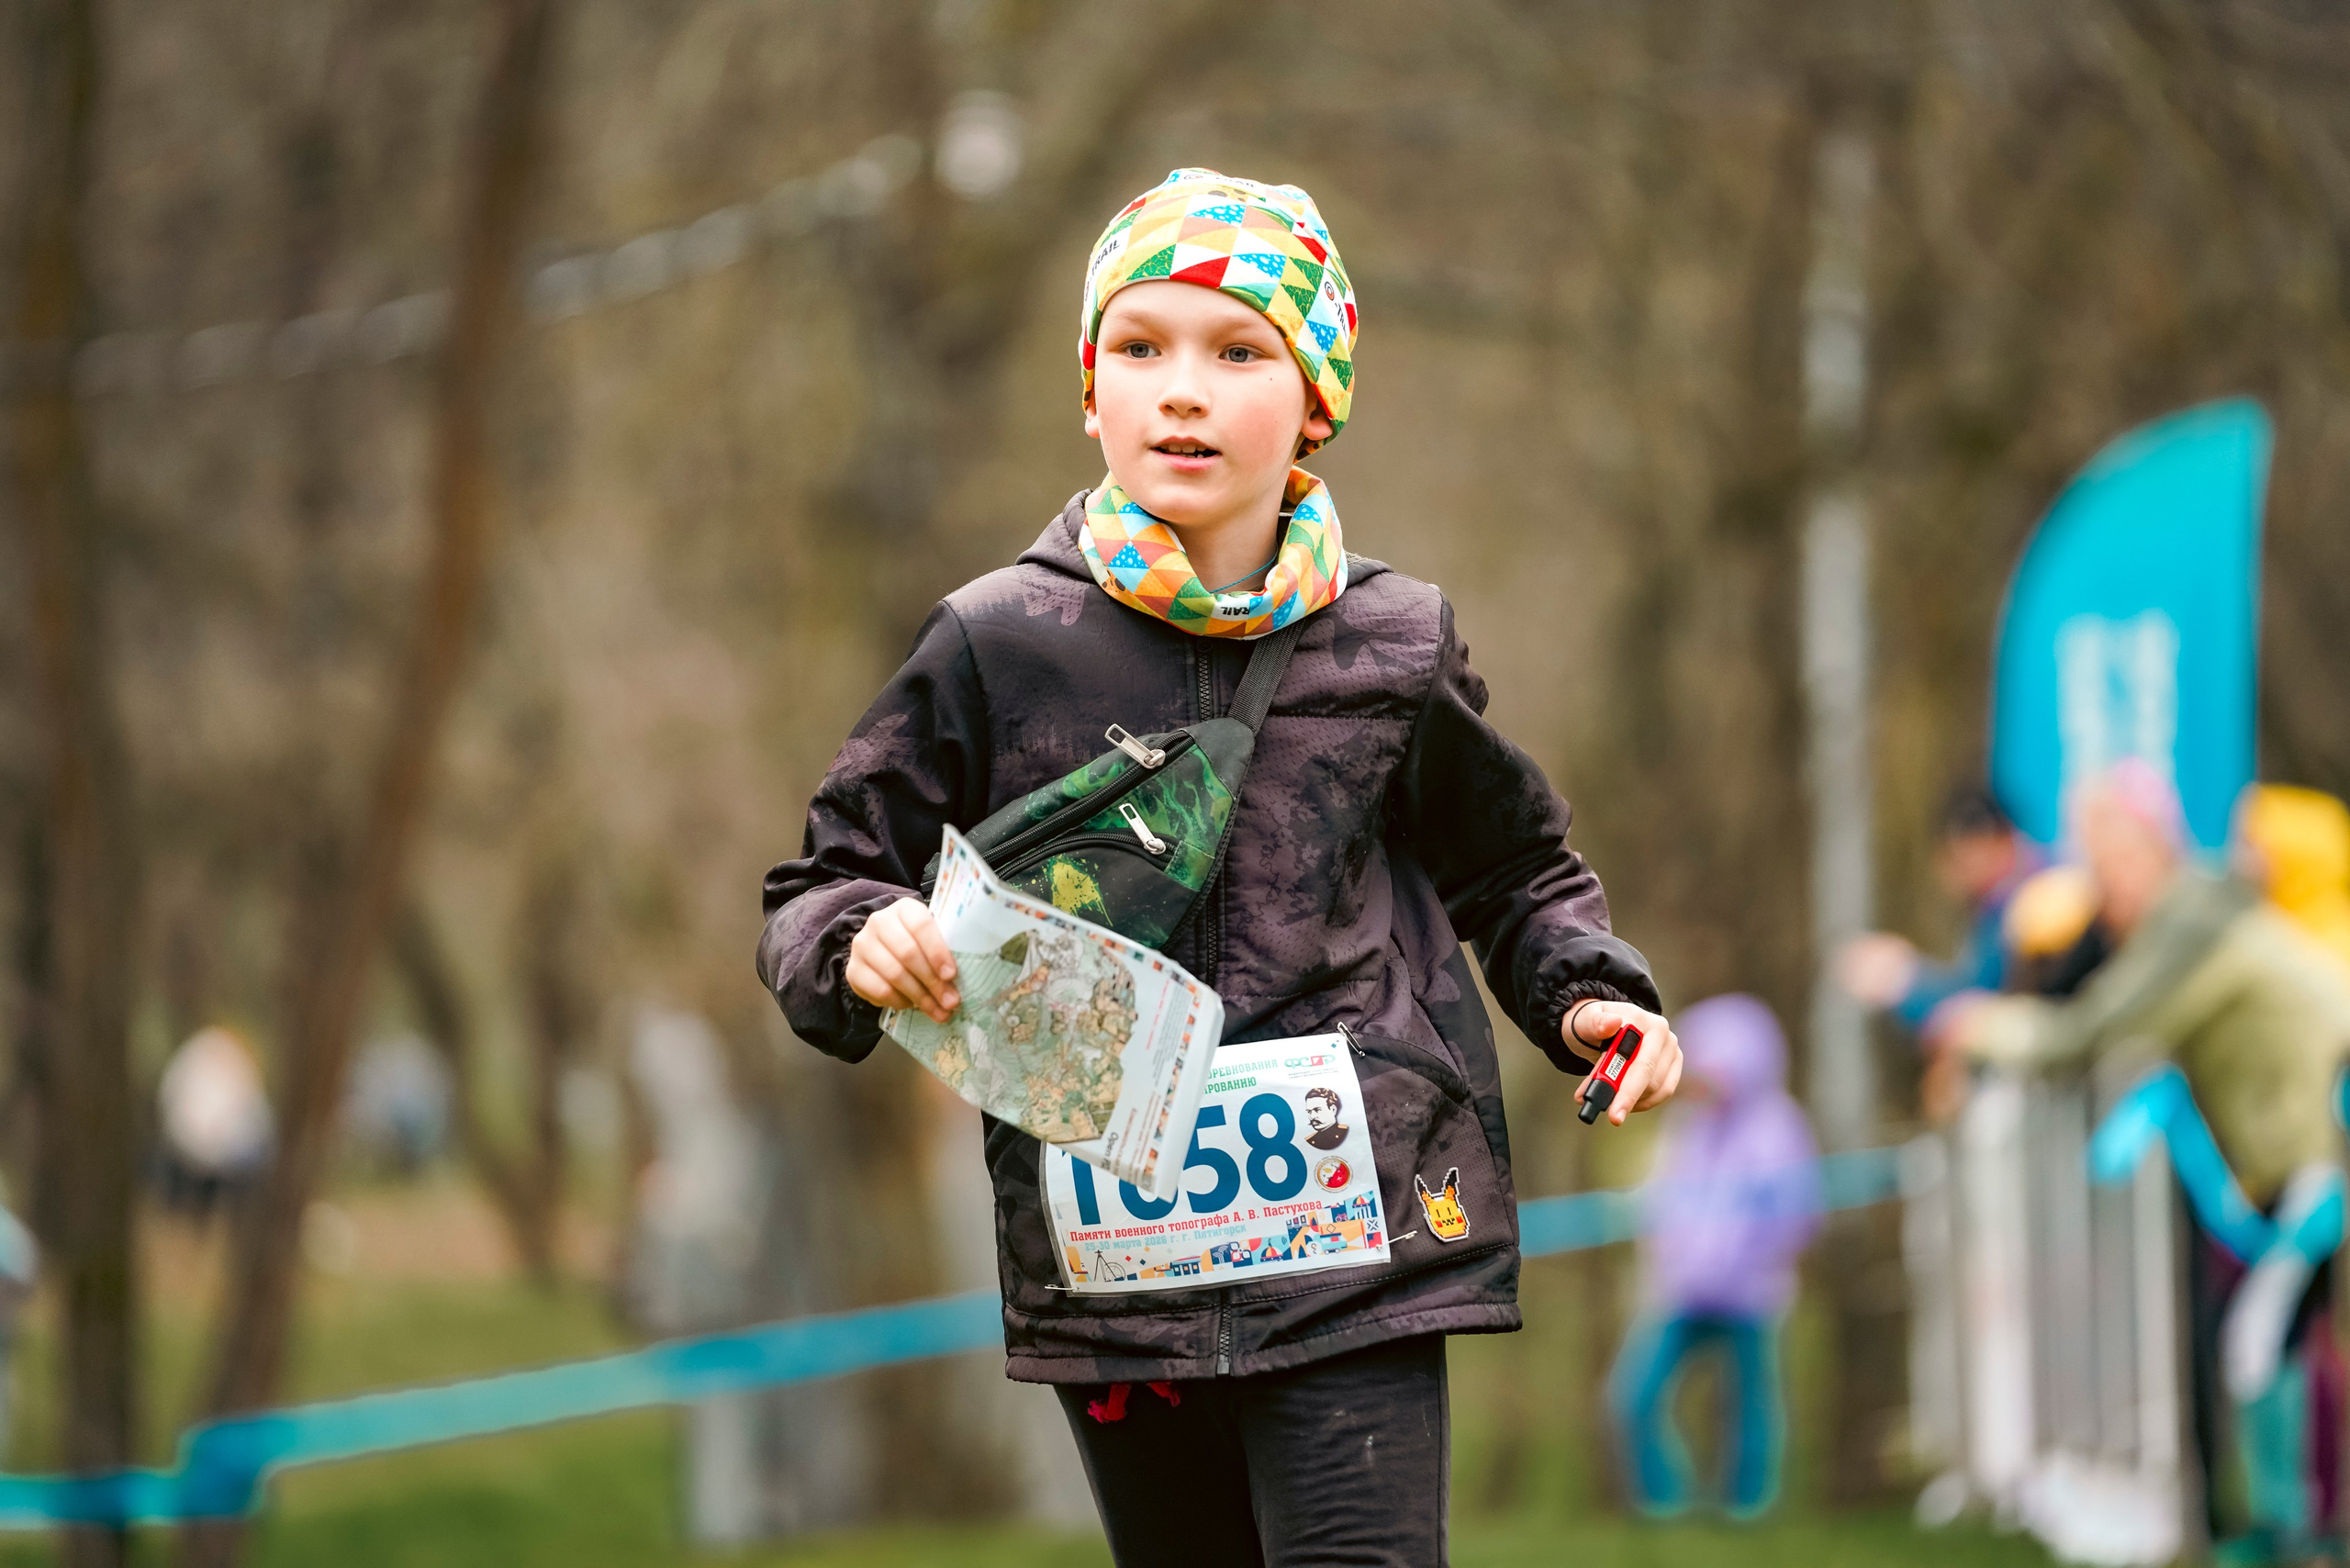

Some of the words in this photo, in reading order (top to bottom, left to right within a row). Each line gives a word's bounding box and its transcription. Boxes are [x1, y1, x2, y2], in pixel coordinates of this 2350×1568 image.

[1203, 1077, 1258, 1094] РОВАНИЮ
[1070, 1230, 1112, 1242] Памяти
[1115, 1224, 1165, 1238] военного
[1168, 1215, 1230, 1232] топографа
[1234, 1211, 1245, 1223] А.
[1248, 1209, 1259, 1220] В.
[1263, 1199, 1323, 1217] Пастухова
[1113, 1238, 1142, 1250] марта
[1145, 1235, 1168, 1246] 2026
[1193, 1224, 1247, 1240] Пятигорск
